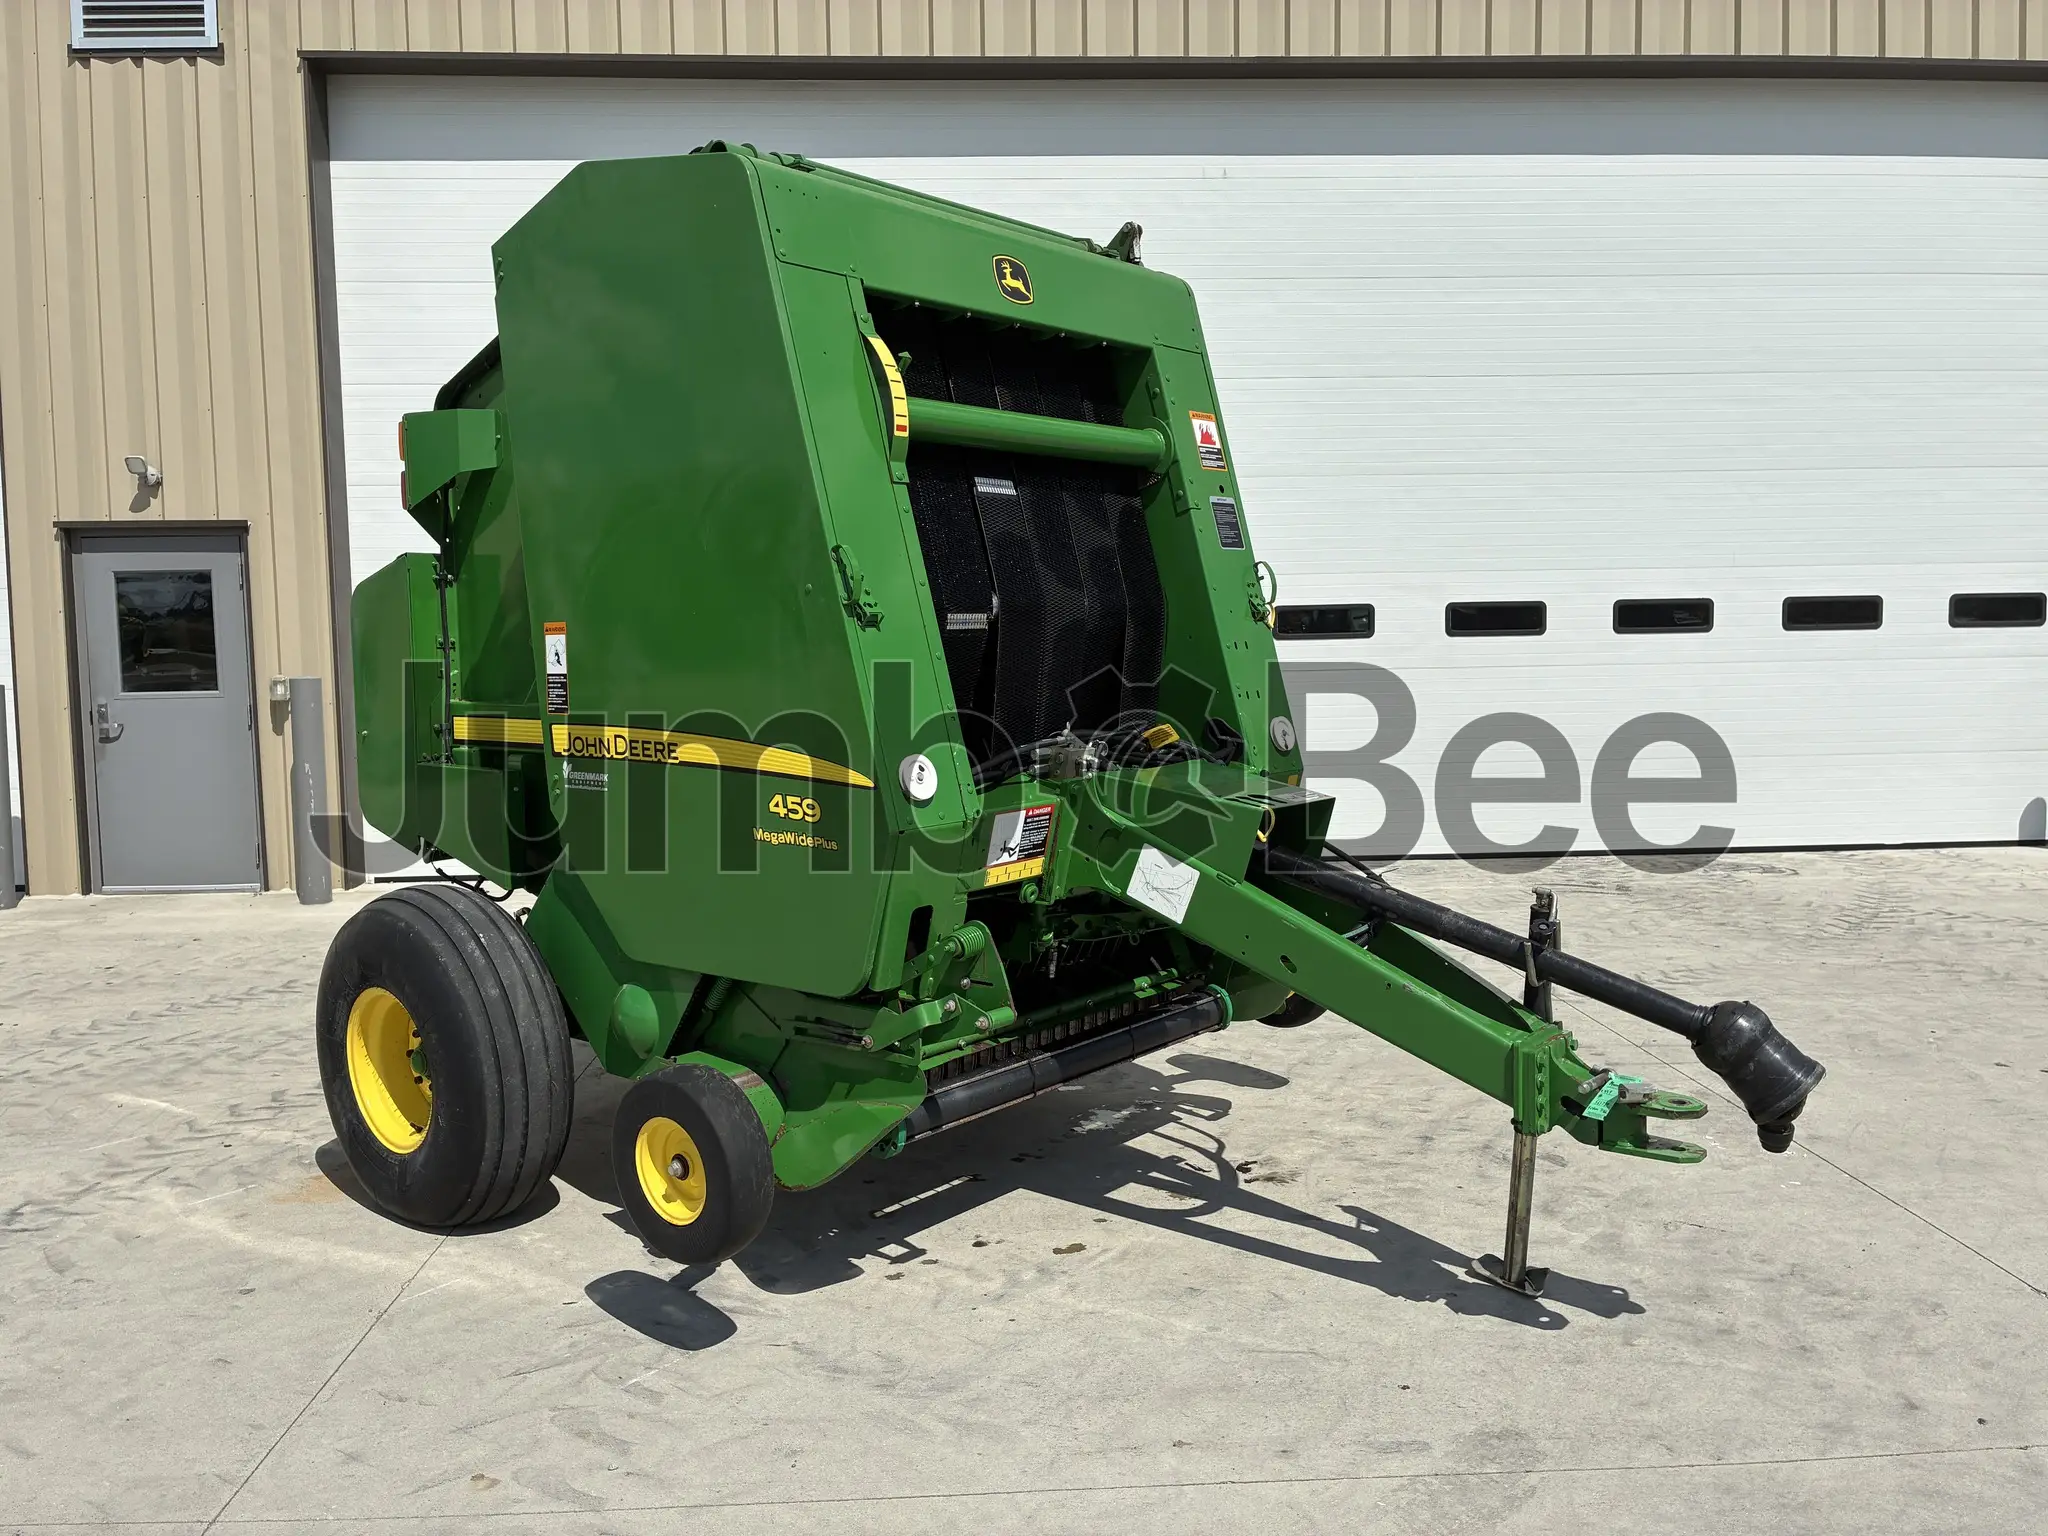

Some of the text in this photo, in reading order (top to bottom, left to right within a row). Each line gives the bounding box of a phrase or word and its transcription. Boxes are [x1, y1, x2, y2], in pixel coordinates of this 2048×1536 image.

[562, 732, 680, 763] JOHN DEERE
[569, 771, 608, 782] GREENMARK
[768, 793, 822, 823] 459
[1033, 806, 1052, 815] DANGER
